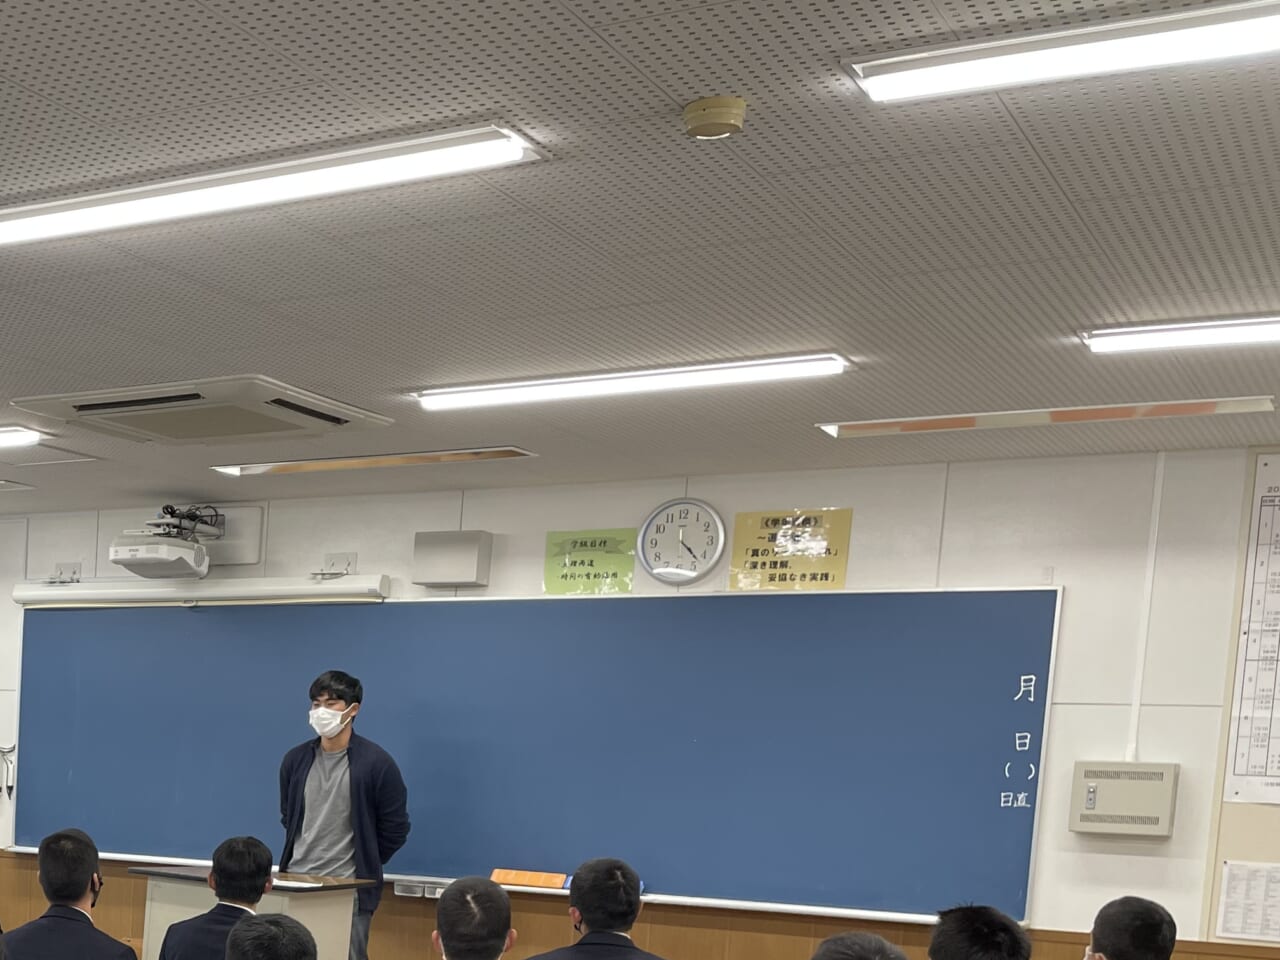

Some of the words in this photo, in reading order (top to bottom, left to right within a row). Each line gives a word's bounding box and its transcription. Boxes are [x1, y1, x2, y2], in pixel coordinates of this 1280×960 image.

[665, 512, 674, 523] 11
[679, 508, 689, 520] 12
[655, 523, 666, 534] 10
[703, 521, 711, 533] 2
[650, 538, 658, 549] 9
[706, 535, 714, 546] 3
[654, 551, 662, 562] 8
[700, 549, 707, 560] 4
[690, 560, 697, 572] 5
[1013, 674, 1037, 702] 月
[1015, 732, 1032, 751] 日
[1000, 792, 1032, 808] 日直
